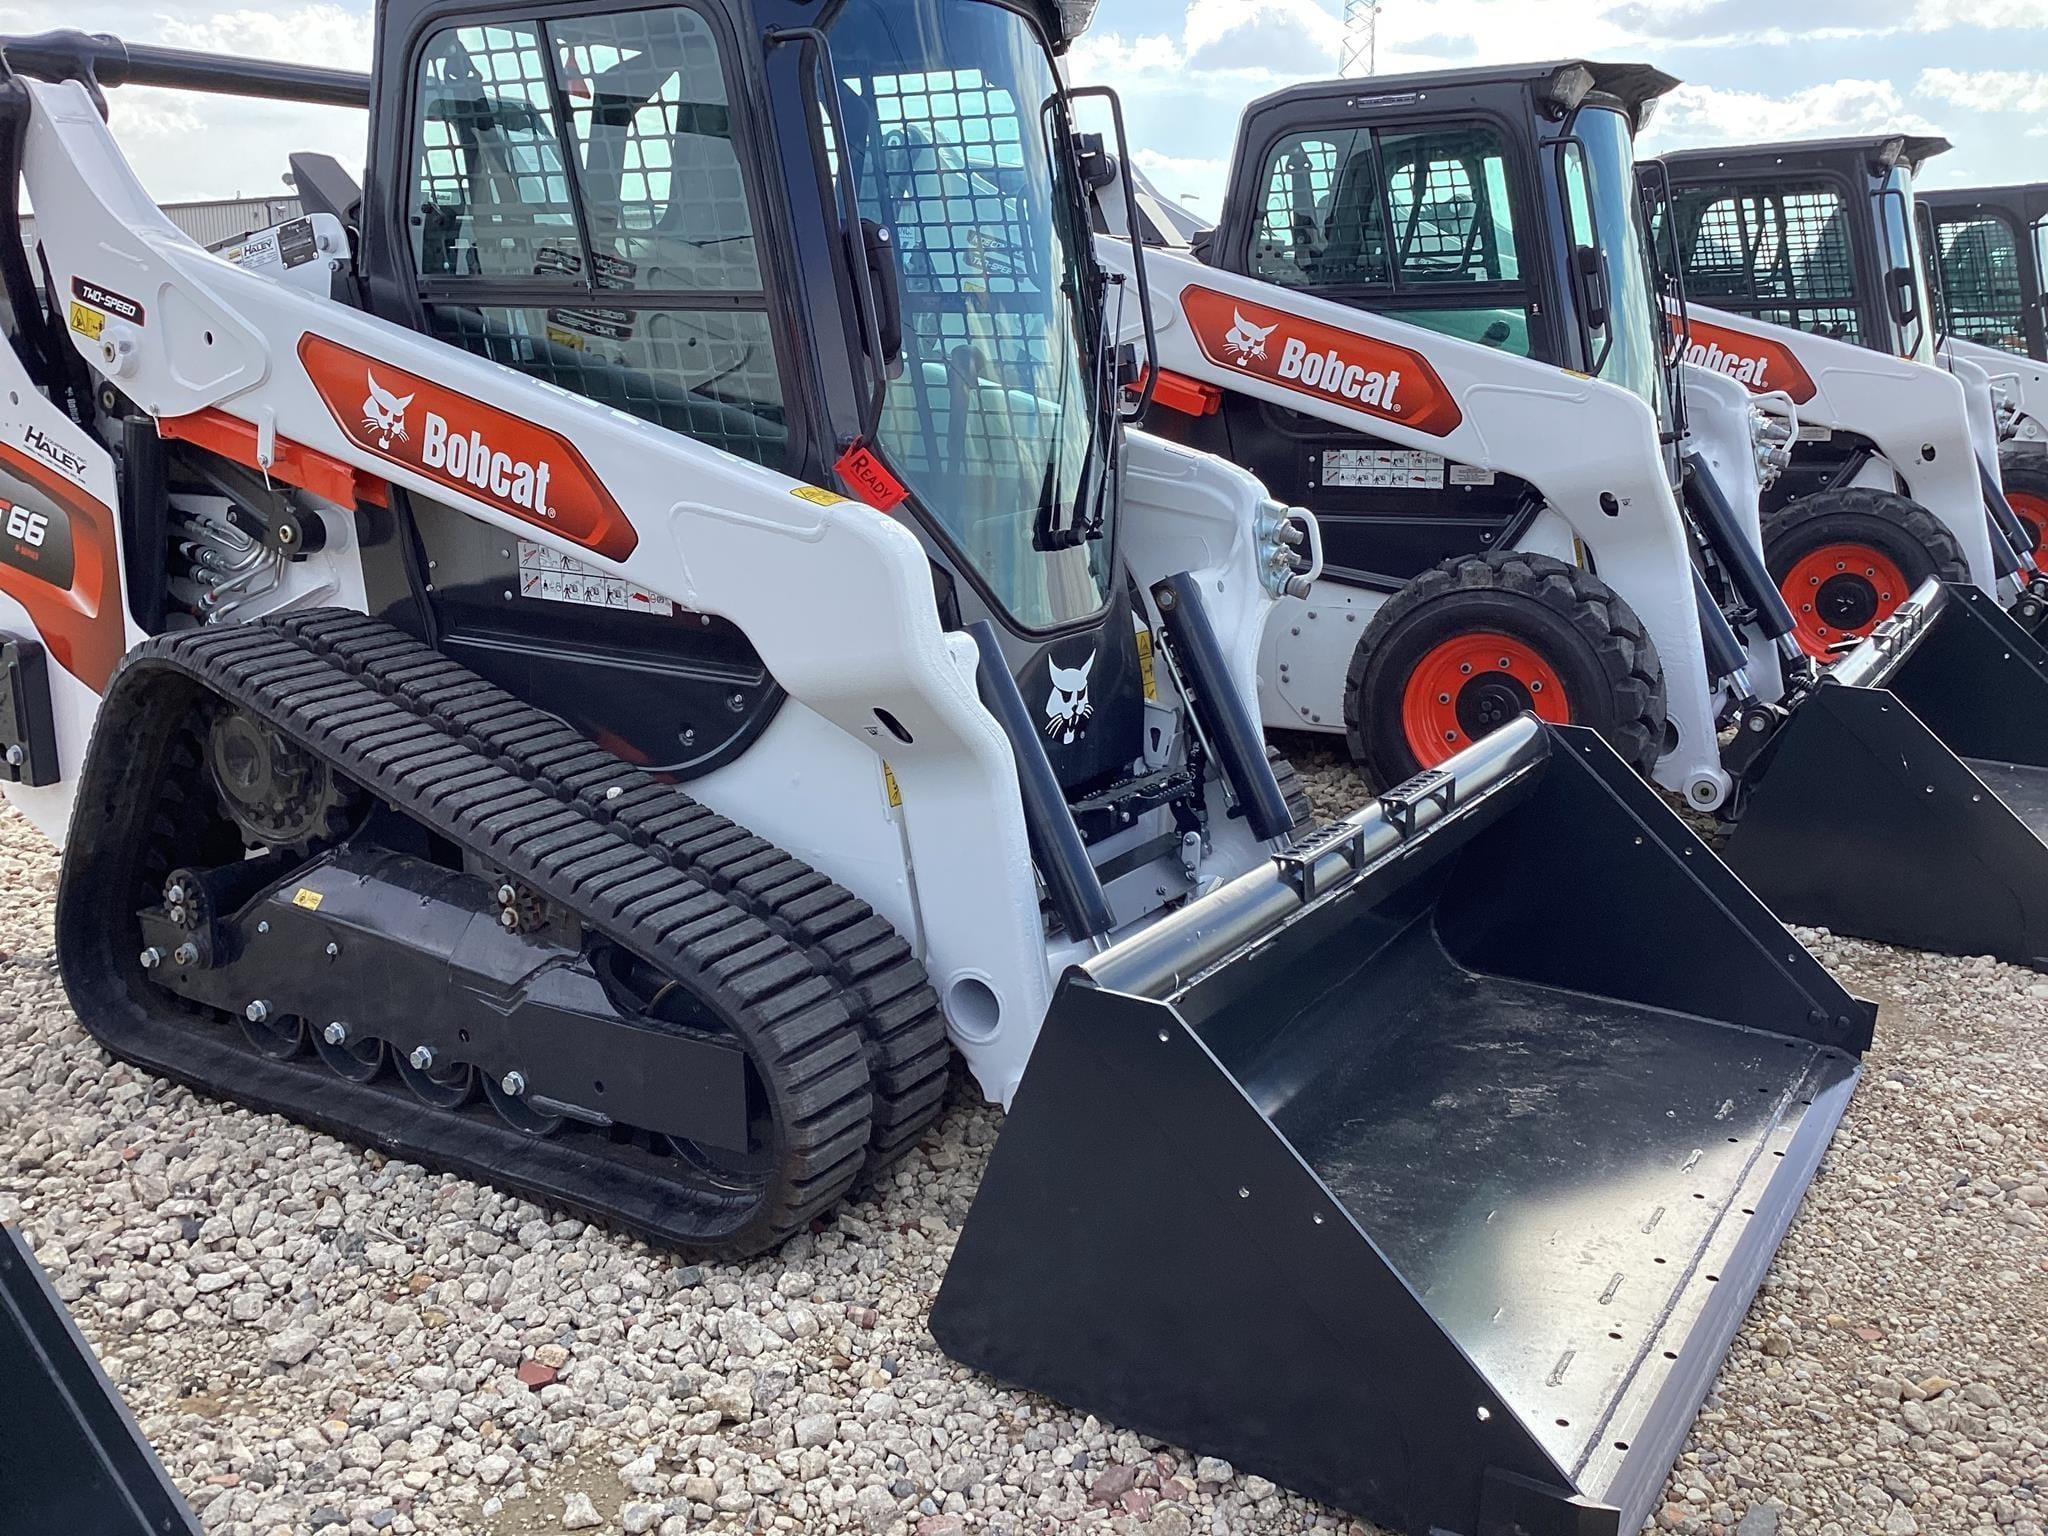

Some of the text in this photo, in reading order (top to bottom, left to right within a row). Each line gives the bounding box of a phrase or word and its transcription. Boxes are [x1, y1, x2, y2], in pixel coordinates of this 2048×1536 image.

[244, 239, 273, 257] HALEY
[82, 286, 137, 317] TWO-SPEED
[1277, 336, 1399, 411] Bobcat
[24, 425, 87, 475] HALEY
[422, 410, 550, 518] Bobcat
[851, 453, 893, 499] READY
